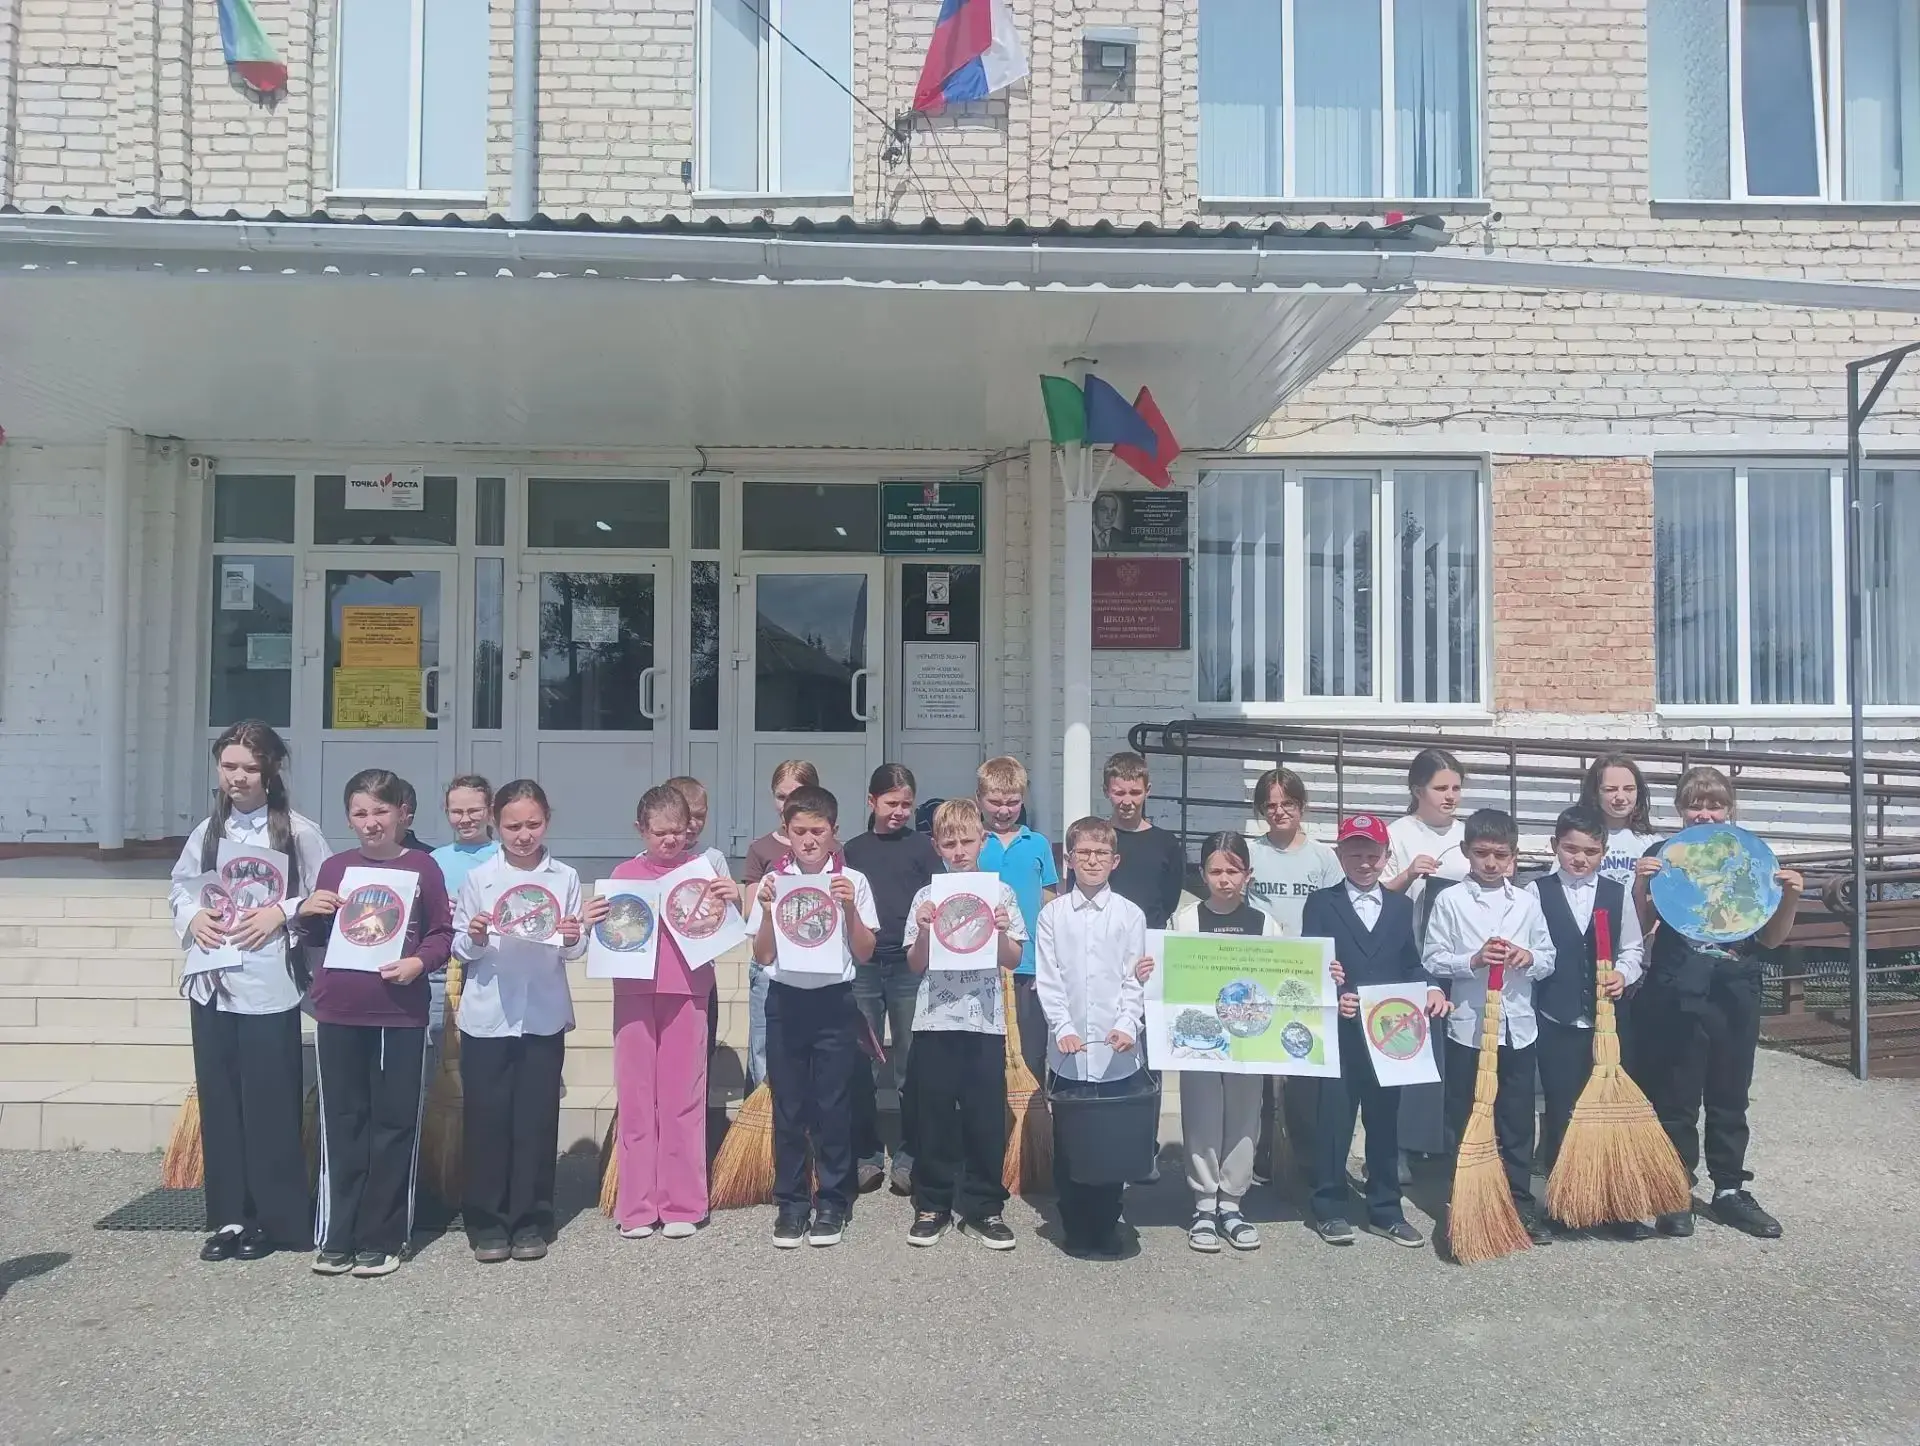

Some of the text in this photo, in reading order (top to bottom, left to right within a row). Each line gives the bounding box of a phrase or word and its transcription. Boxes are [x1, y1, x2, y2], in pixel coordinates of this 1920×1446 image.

[350, 480, 419, 488] ТОЧКА РОСТА
[1103, 615, 1136, 624] ШКОЛА
